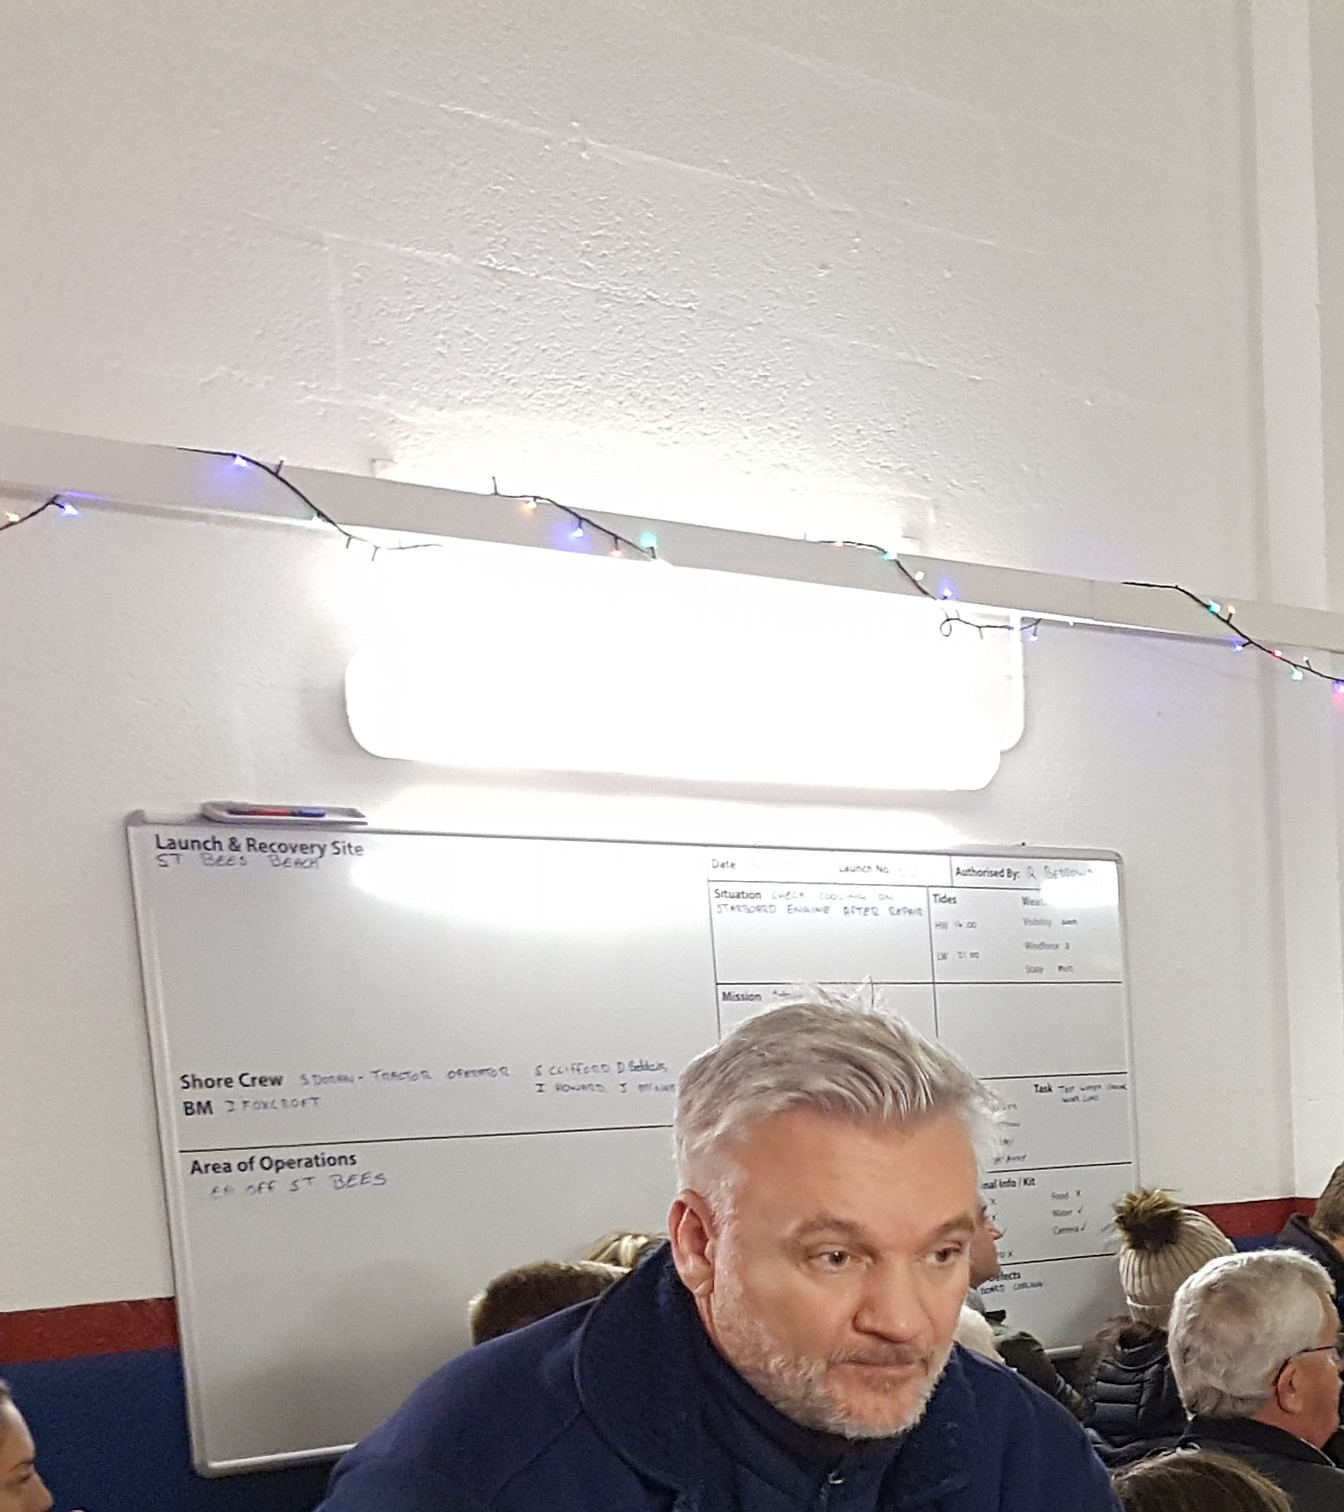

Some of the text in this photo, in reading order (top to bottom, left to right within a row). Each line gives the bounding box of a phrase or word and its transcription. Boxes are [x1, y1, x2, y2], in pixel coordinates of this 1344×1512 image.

[155, 834, 364, 858] Launch & Recovery Site
[155, 853, 320, 869] ST BEES BEACH
[711, 858, 736, 870] Date
[839, 864, 872, 874] Launch
[956, 867, 1005, 879] Authorised
[714, 889, 762, 900] Situation
[933, 893, 957, 905] Tides
[787, 903, 831, 915] ENGINE
[843, 905, 880, 917] AFTER
[722, 990, 762, 1002] Mission
[180, 1072, 283, 1090] Shore Crew
[1034, 1083, 1053, 1093] Task
[184, 1100, 214, 1116] BM
[243, 1096, 321, 1111] FOXCROFT
[190, 1152, 357, 1175] Area of Operations
[289, 1176, 315, 1192] ST
[330, 1172, 387, 1191] BEES
[1023, 1177, 1036, 1187] Kit
[1052, 1191, 1070, 1200] Food
